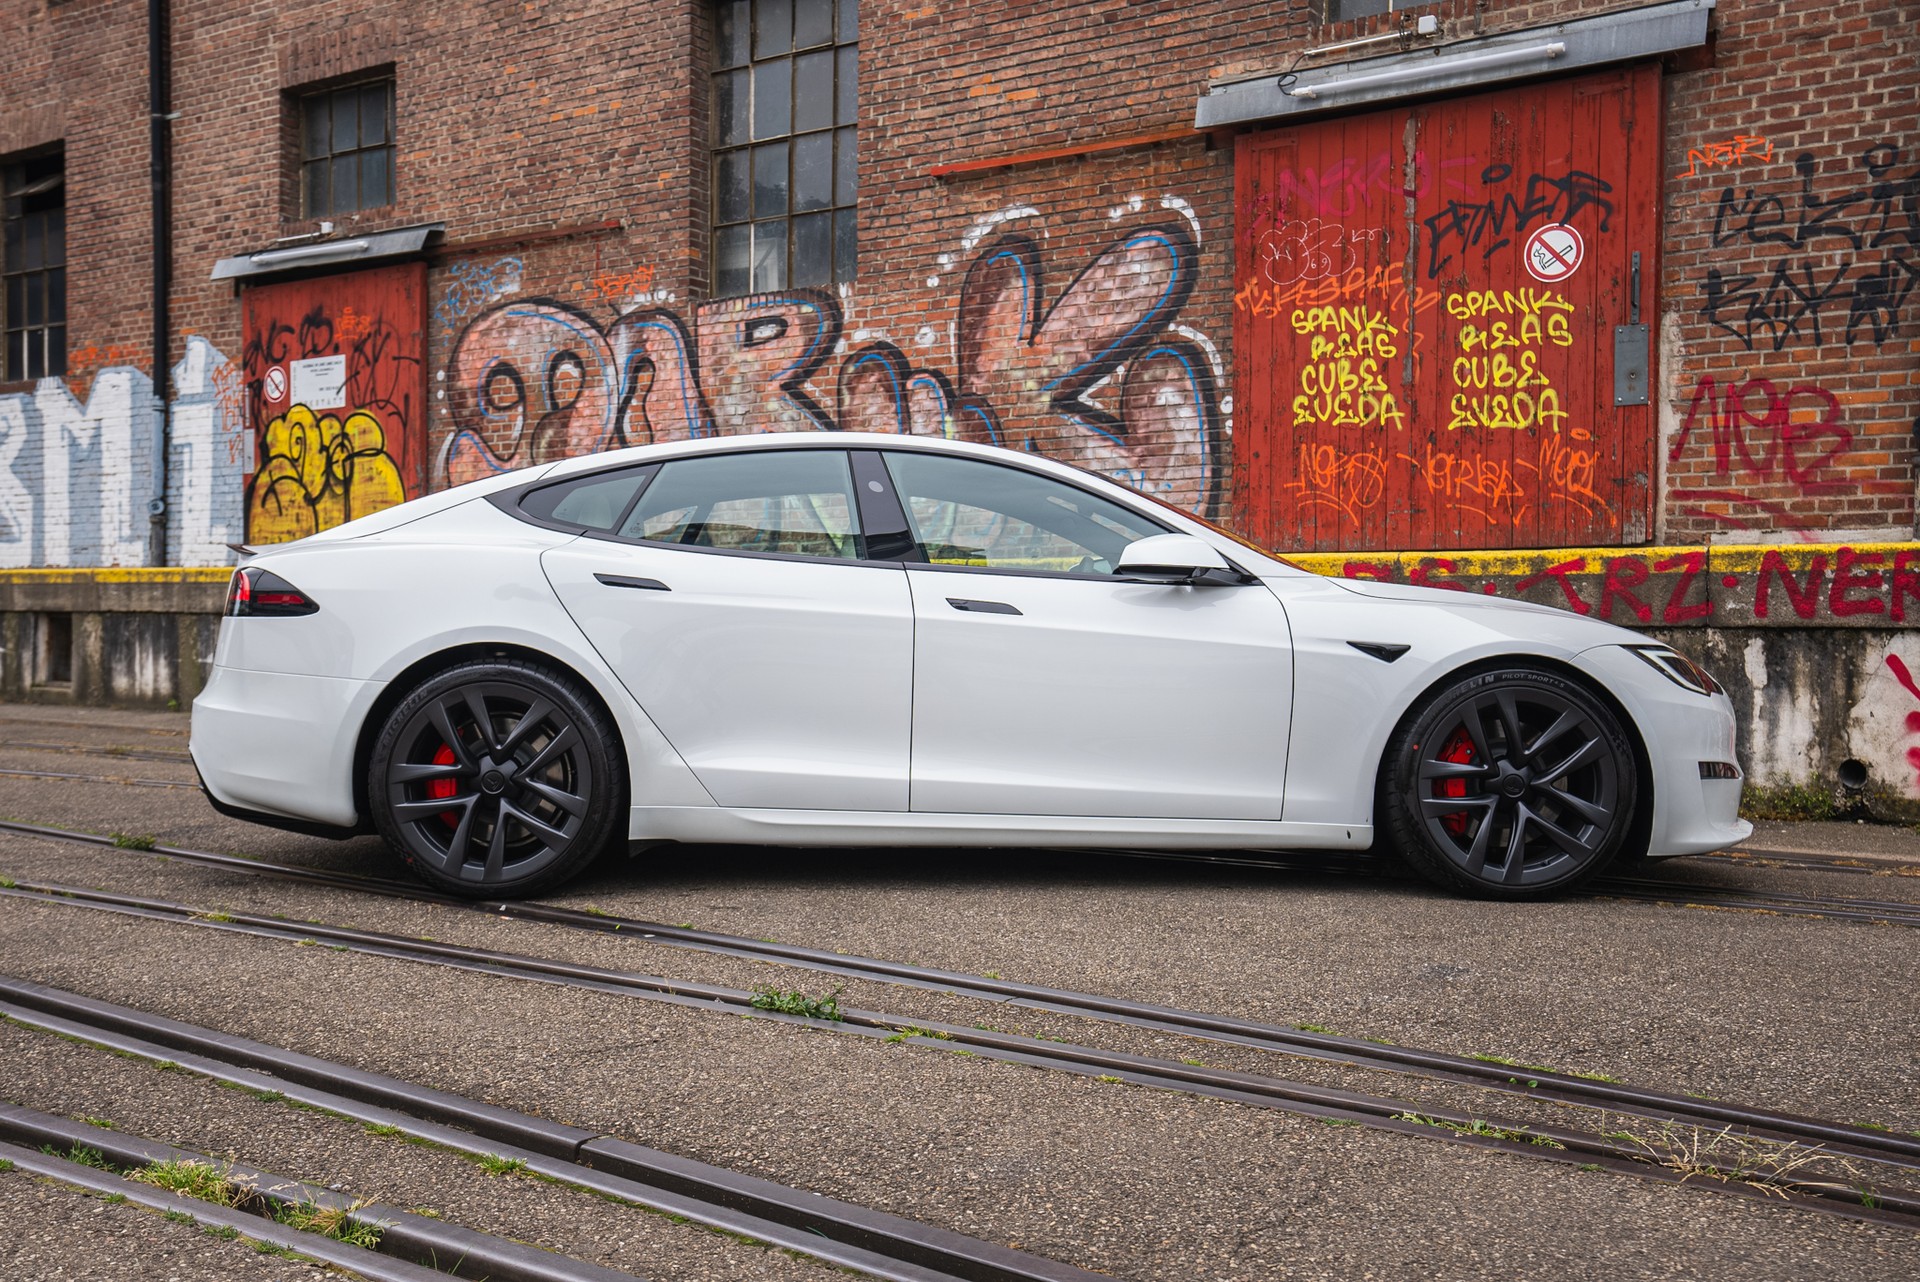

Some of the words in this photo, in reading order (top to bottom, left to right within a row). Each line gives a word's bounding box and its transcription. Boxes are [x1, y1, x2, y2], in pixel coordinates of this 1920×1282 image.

[1291, 304, 1399, 336] SPANK
[1447, 287, 1575, 320] SPANK
[1302, 358, 1388, 395] CUBE
[1452, 350, 1550, 388] CUBE
[1527, 673, 1554, 684] SPORT
